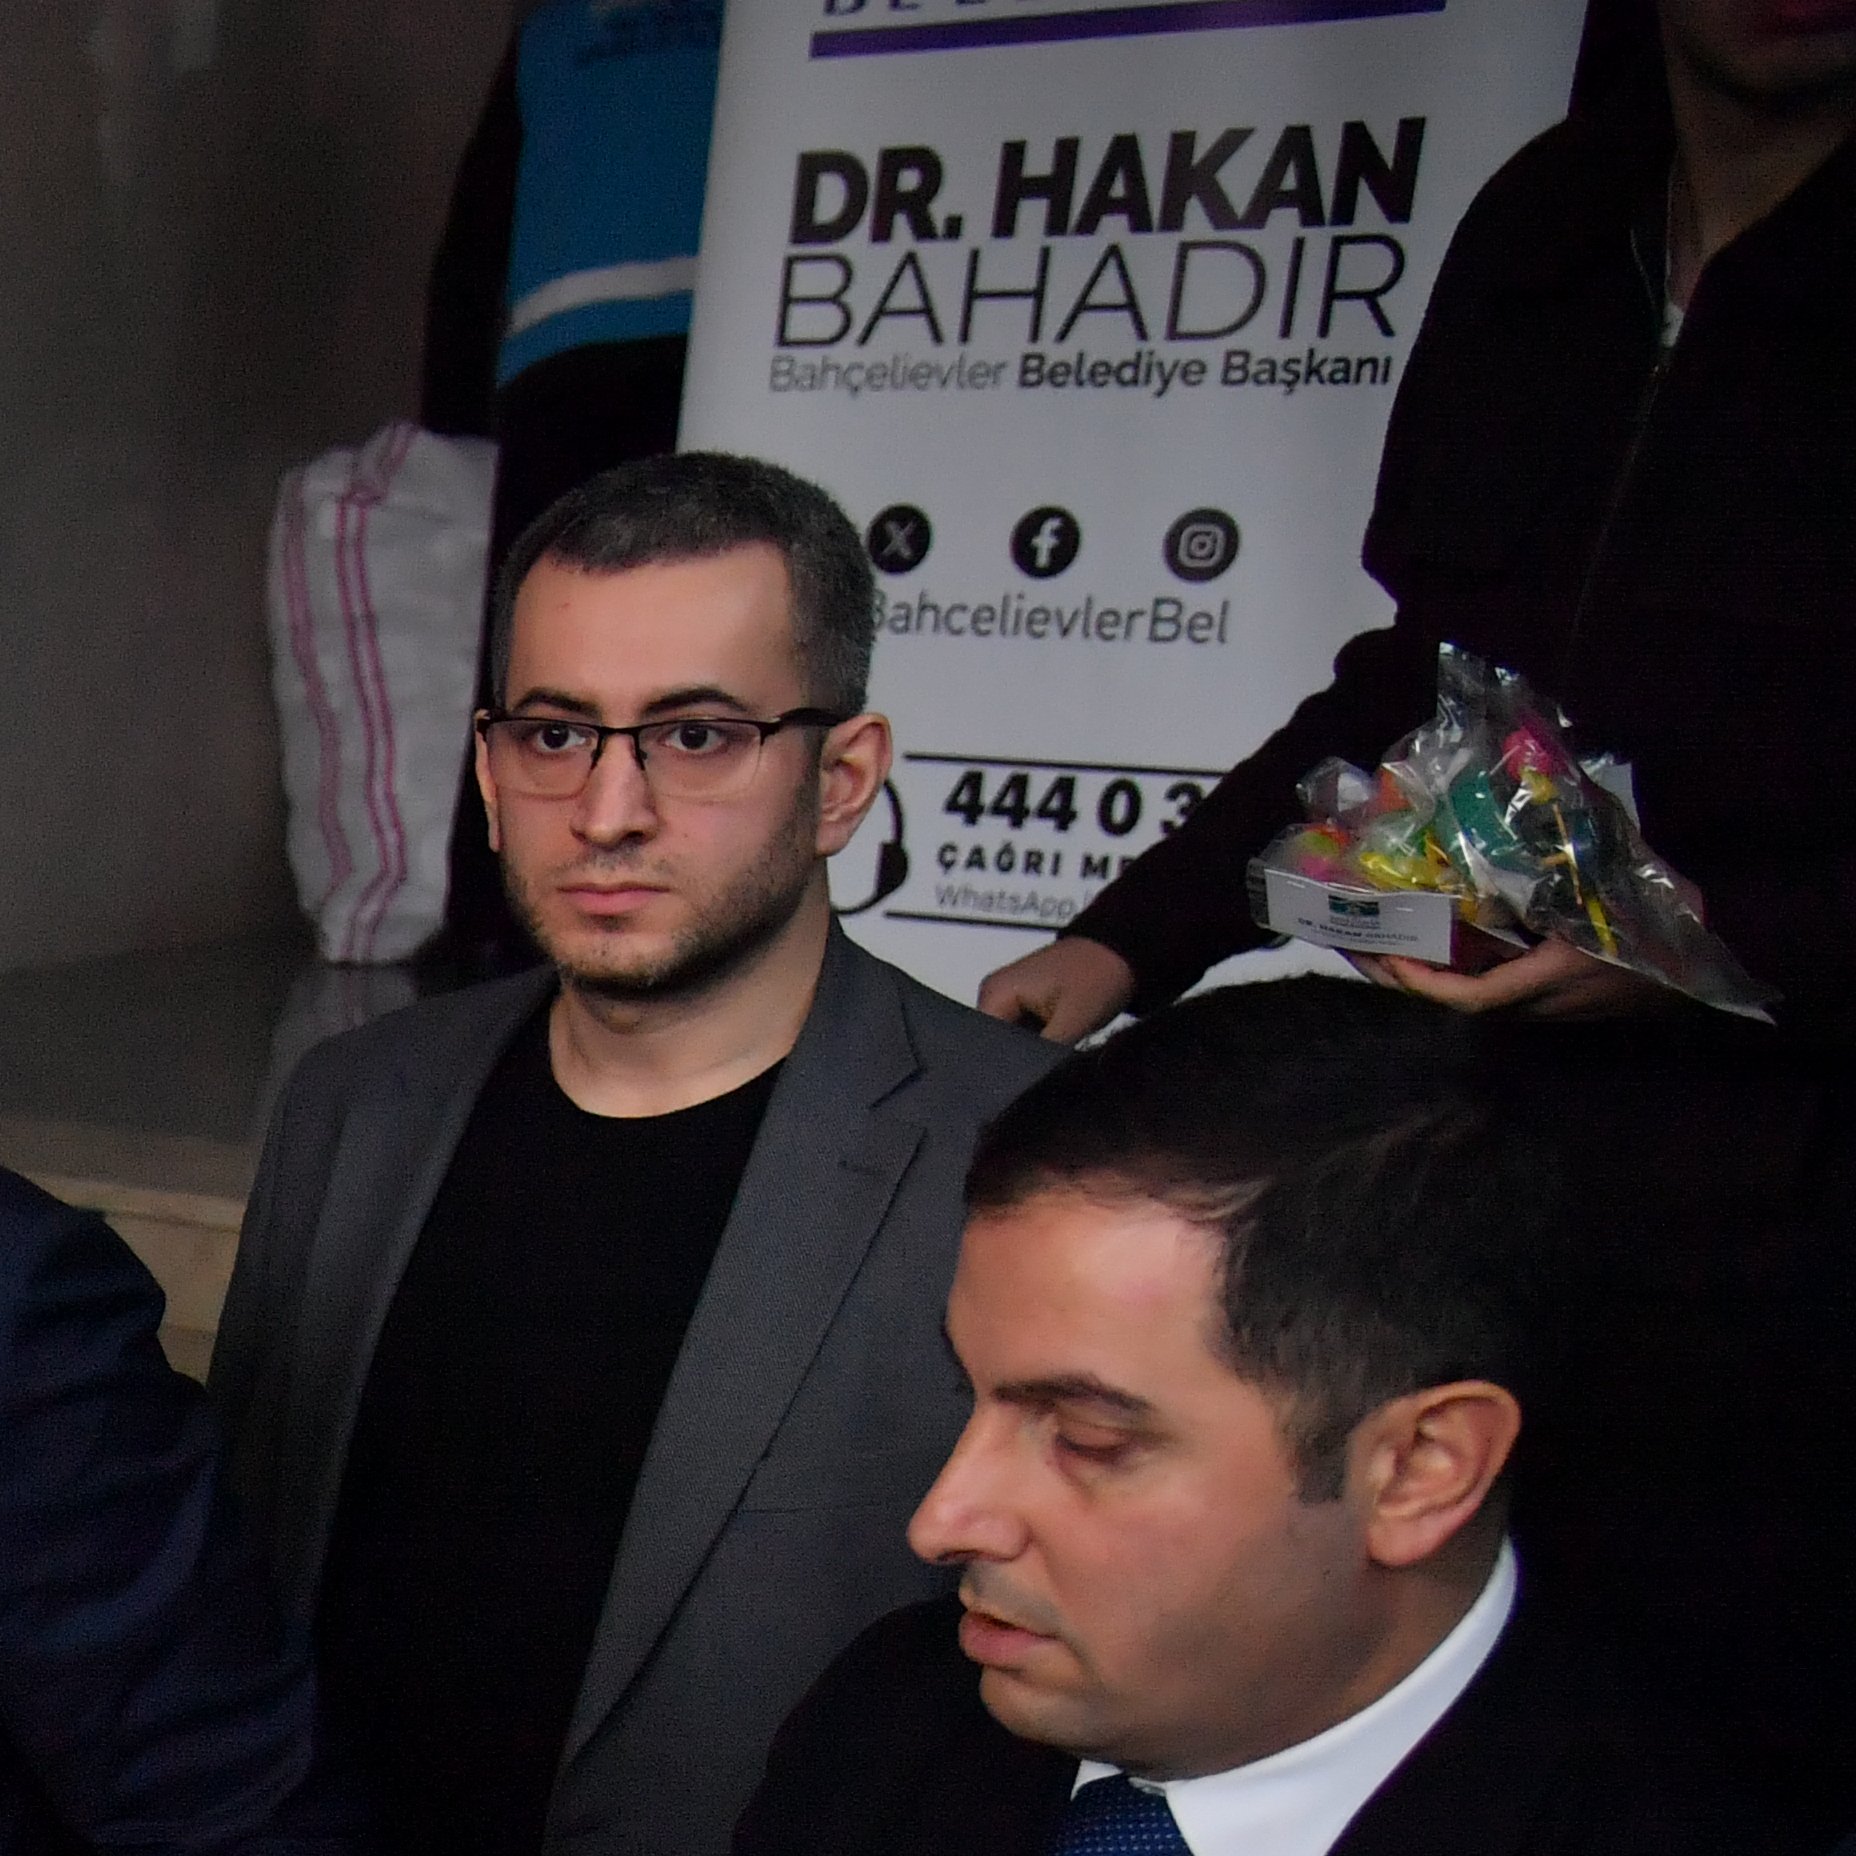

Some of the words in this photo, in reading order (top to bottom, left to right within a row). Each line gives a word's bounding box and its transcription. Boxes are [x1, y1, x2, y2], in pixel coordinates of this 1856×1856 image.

[790, 146, 964, 244] DR.
[992, 116, 1427, 239] HAKAN
[774, 234, 1406, 348] BAHADIR
[768, 352, 1008, 393] Bahçelievler
[1018, 350, 1208, 397] Belediye
[1220, 347, 1392, 395] Başkanı
[945, 770, 1077, 833] 444
[1097, 778, 1143, 837] 0
[937, 841, 1062, 877] ÇAĞRI
